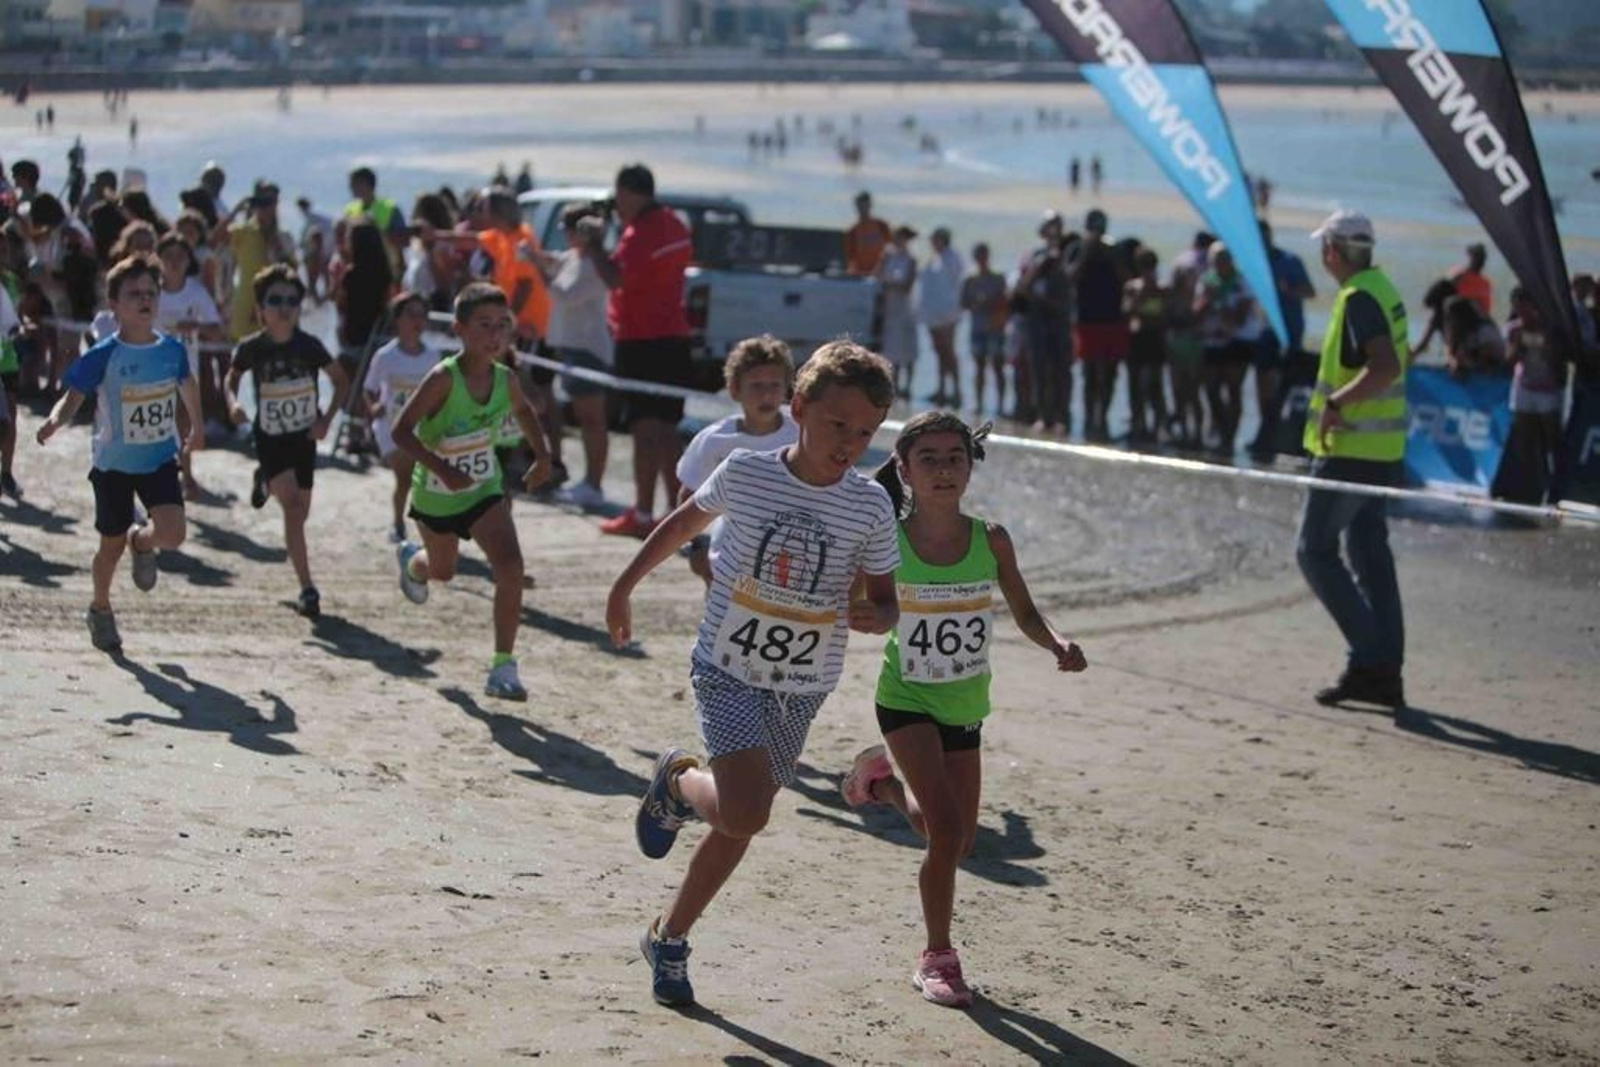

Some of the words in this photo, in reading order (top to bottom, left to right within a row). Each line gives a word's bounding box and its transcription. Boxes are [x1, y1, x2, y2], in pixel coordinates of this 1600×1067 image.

[129, 398, 174, 429] 484
[266, 395, 311, 421] 507
[443, 451, 490, 476] 55
[728, 617, 821, 667] 482
[907, 616, 986, 656] 463
